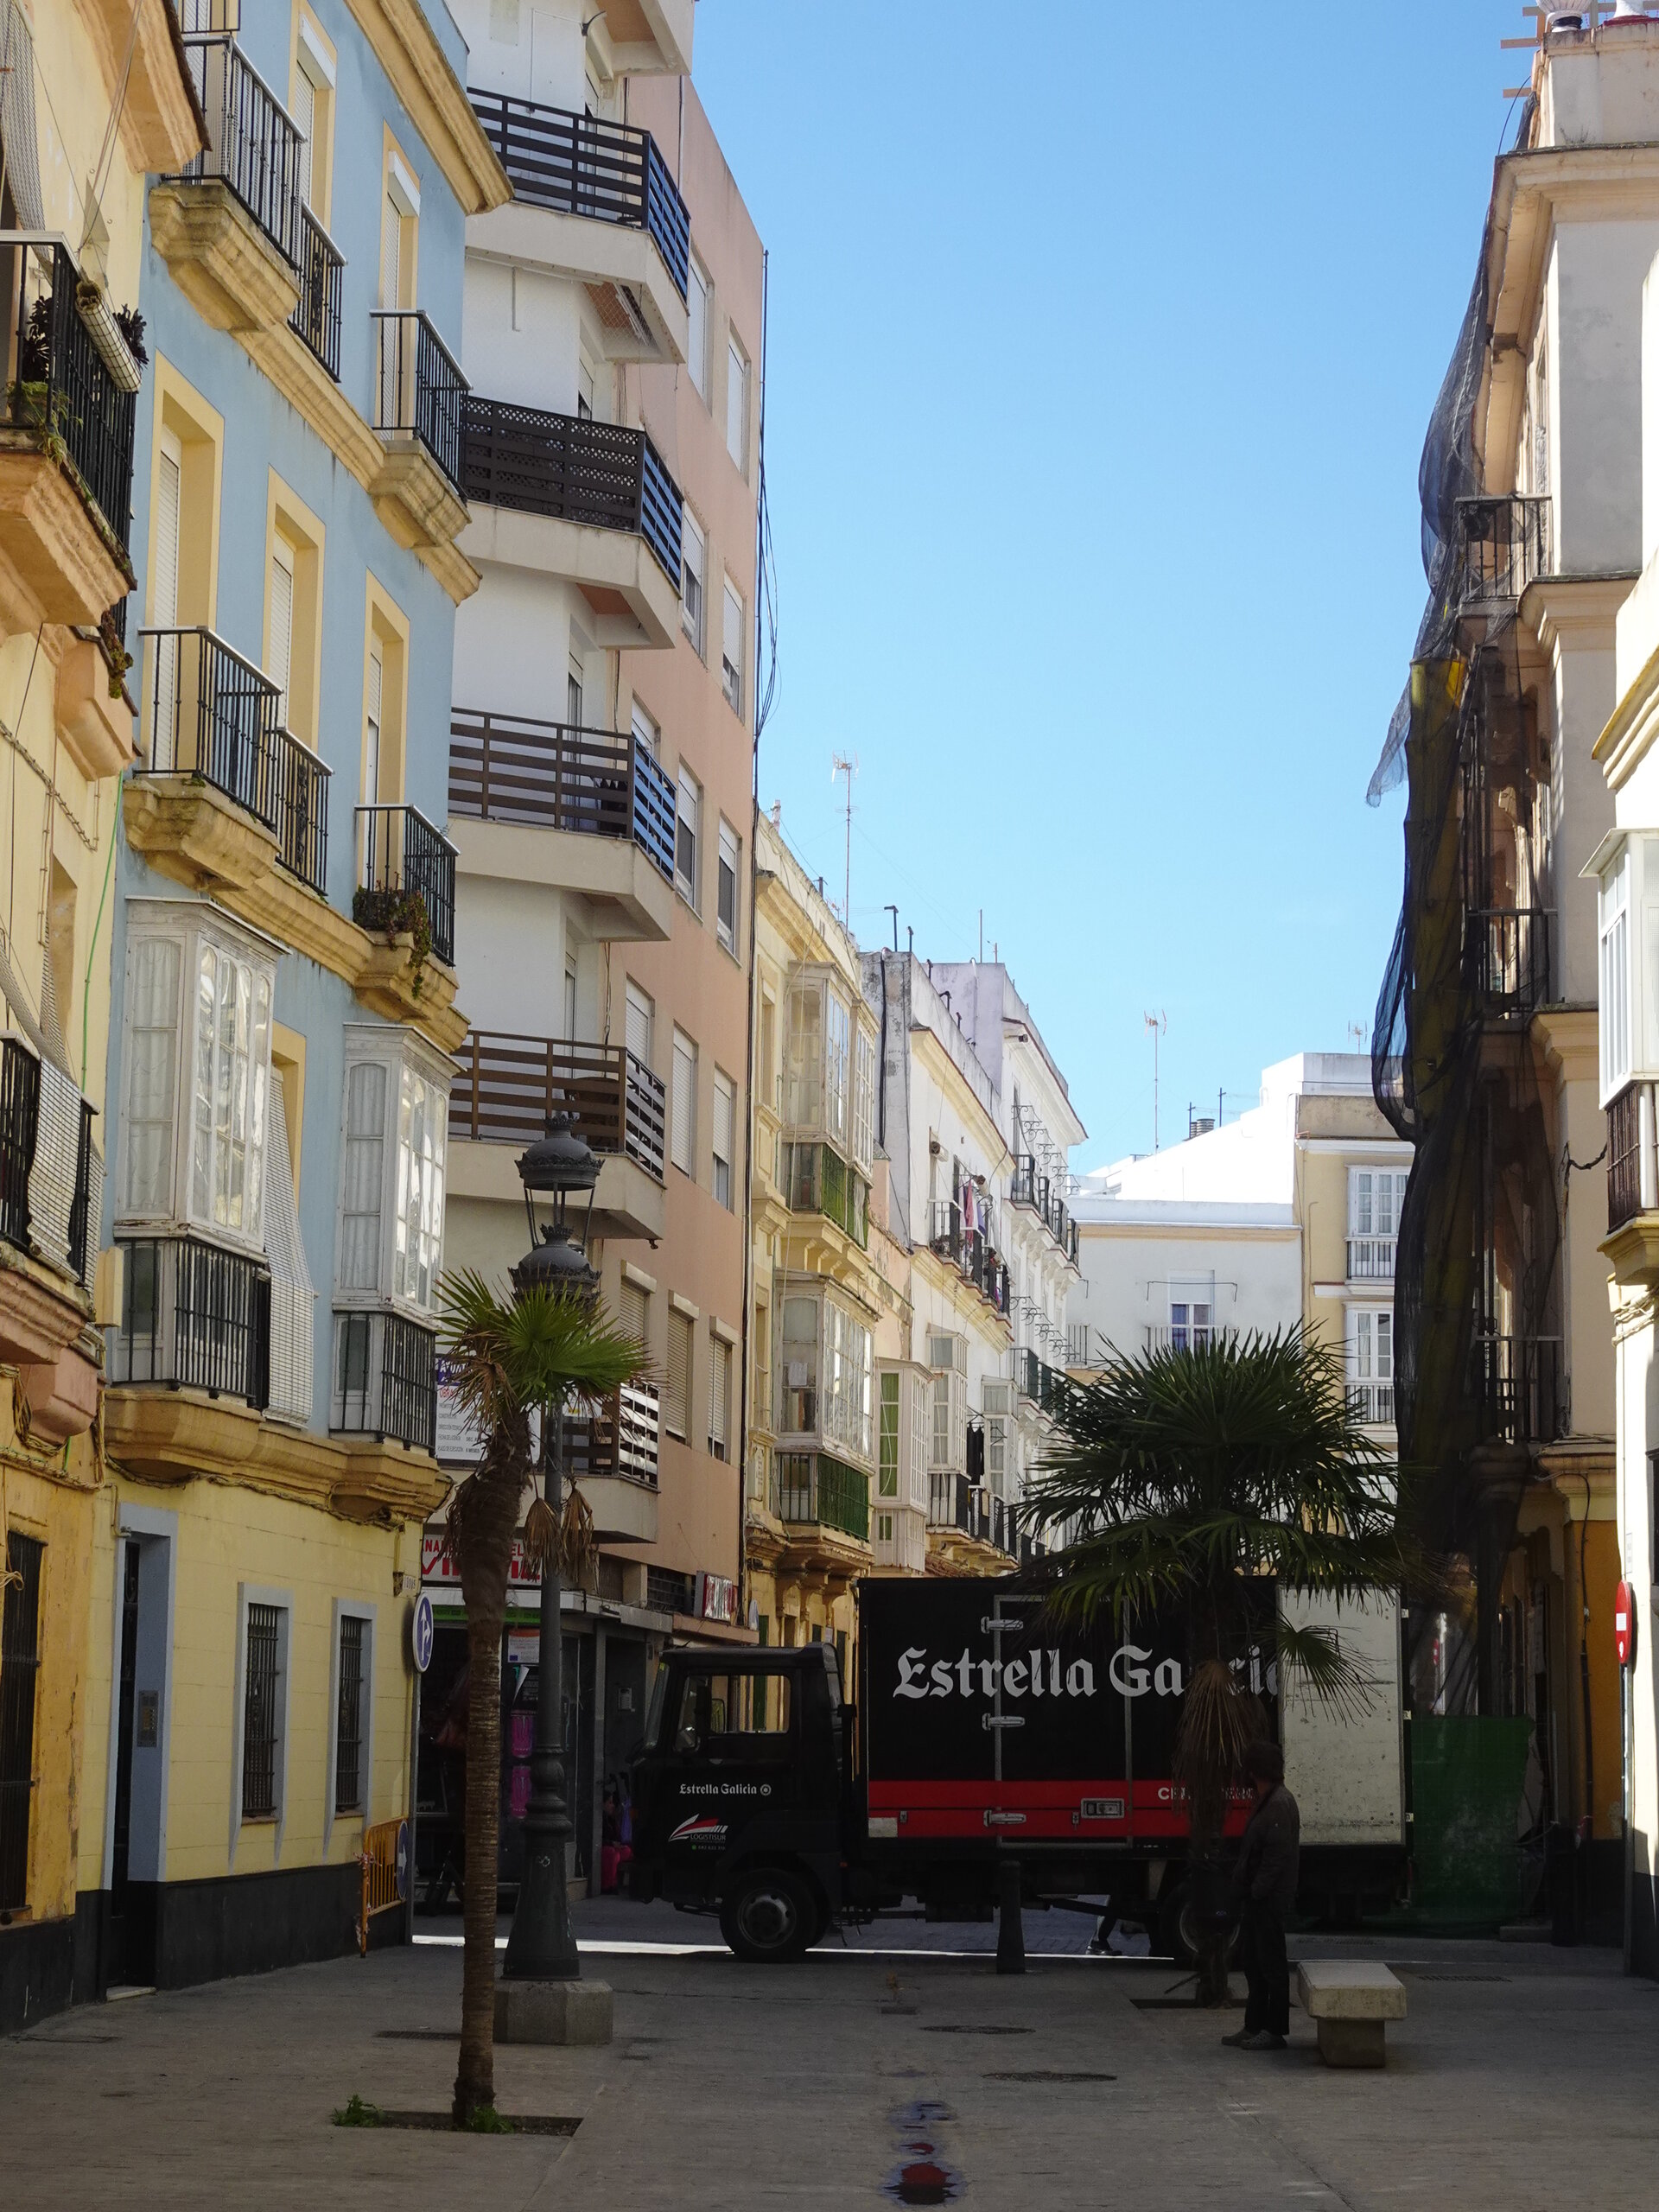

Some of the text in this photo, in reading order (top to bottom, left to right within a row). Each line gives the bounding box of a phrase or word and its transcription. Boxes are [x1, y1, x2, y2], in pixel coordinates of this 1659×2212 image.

[892, 1646, 1097, 1699] Estrella
[679, 1783, 757, 1795] Estrella Galicia
